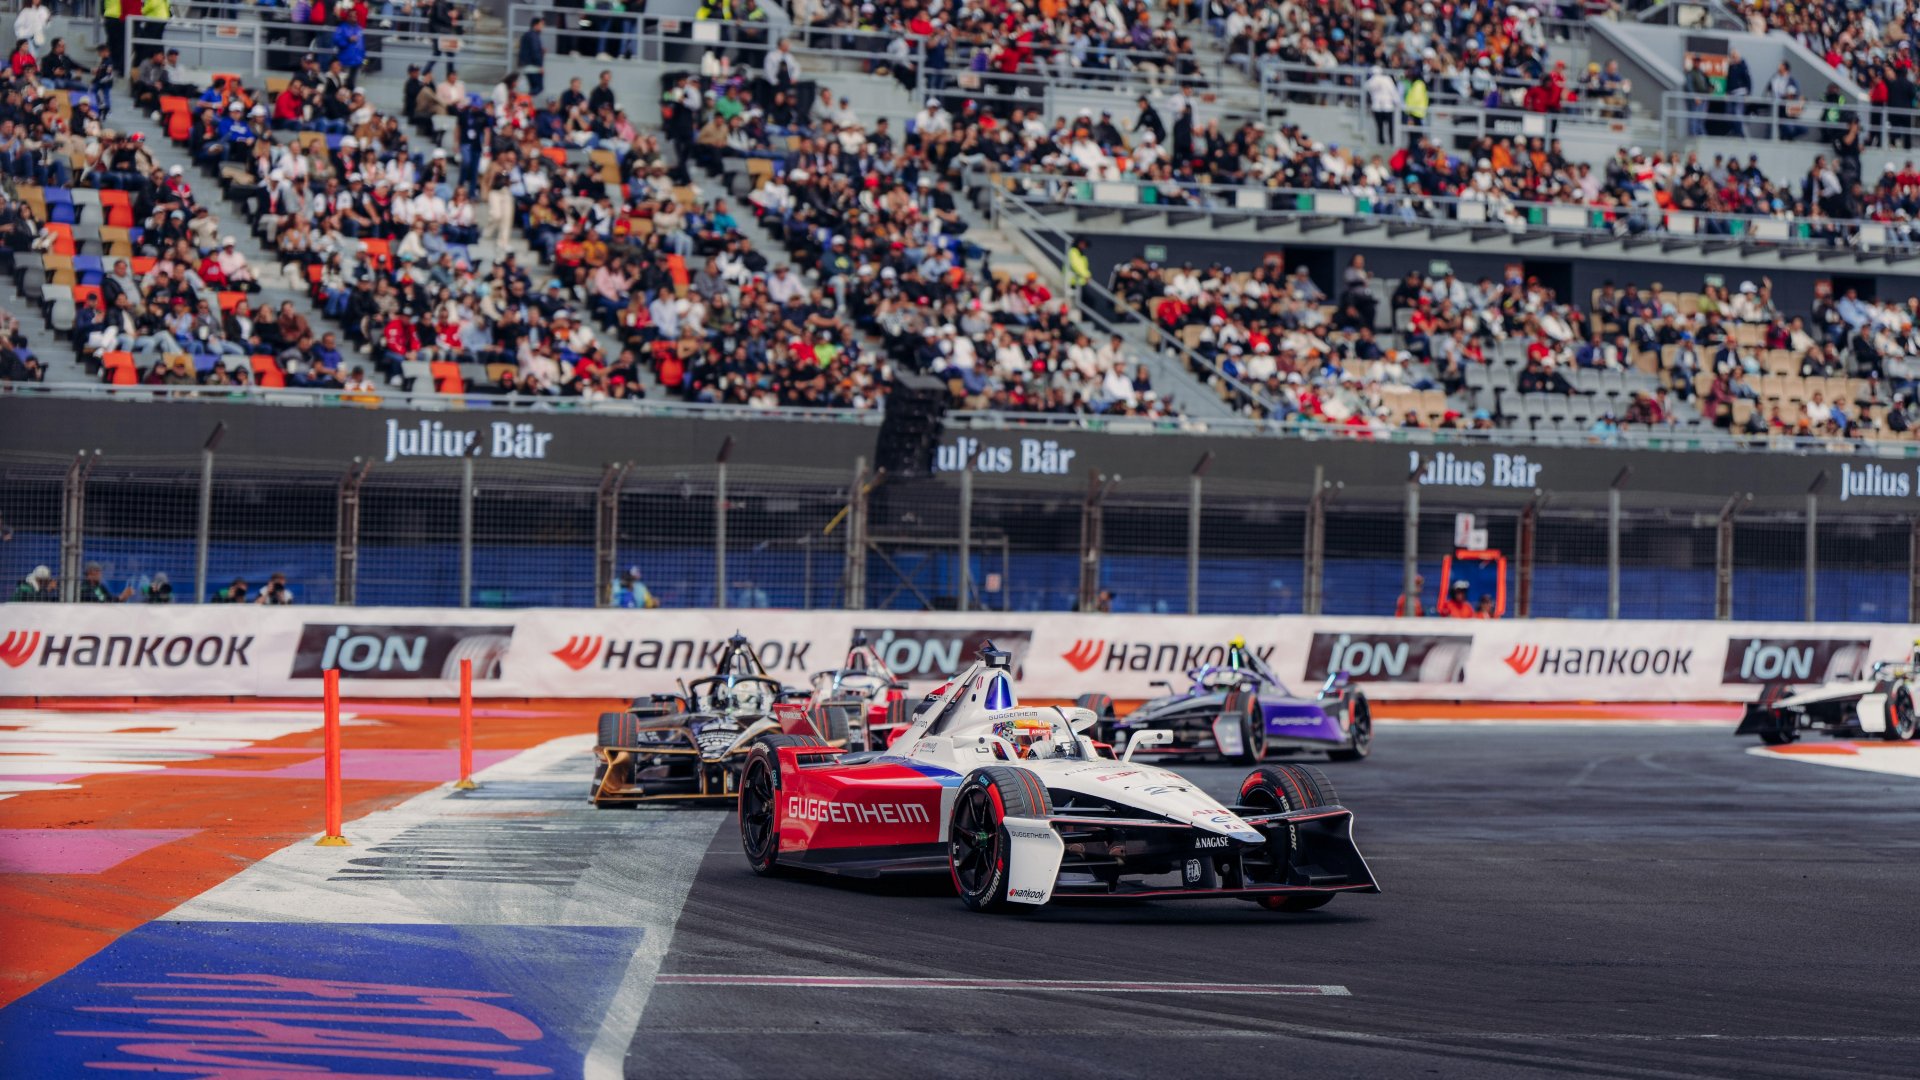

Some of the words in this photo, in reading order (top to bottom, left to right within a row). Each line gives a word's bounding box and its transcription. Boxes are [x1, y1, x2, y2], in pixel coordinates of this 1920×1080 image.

[491, 421, 553, 459] Bär
[1020, 438, 1076, 474] Bär
[1492, 453, 1542, 488] Bär
[1840, 463, 1910, 502] Julius
[39, 635, 255, 667] HANKOOK
[603, 639, 811, 671] HANKOK
[1539, 648, 1692, 676] HANKOOK
[988, 711, 1038, 721] GUGGENHEIM
[788, 796, 930, 824] GUGGENHEIM
[1201, 836, 1230, 848] NAGASE
